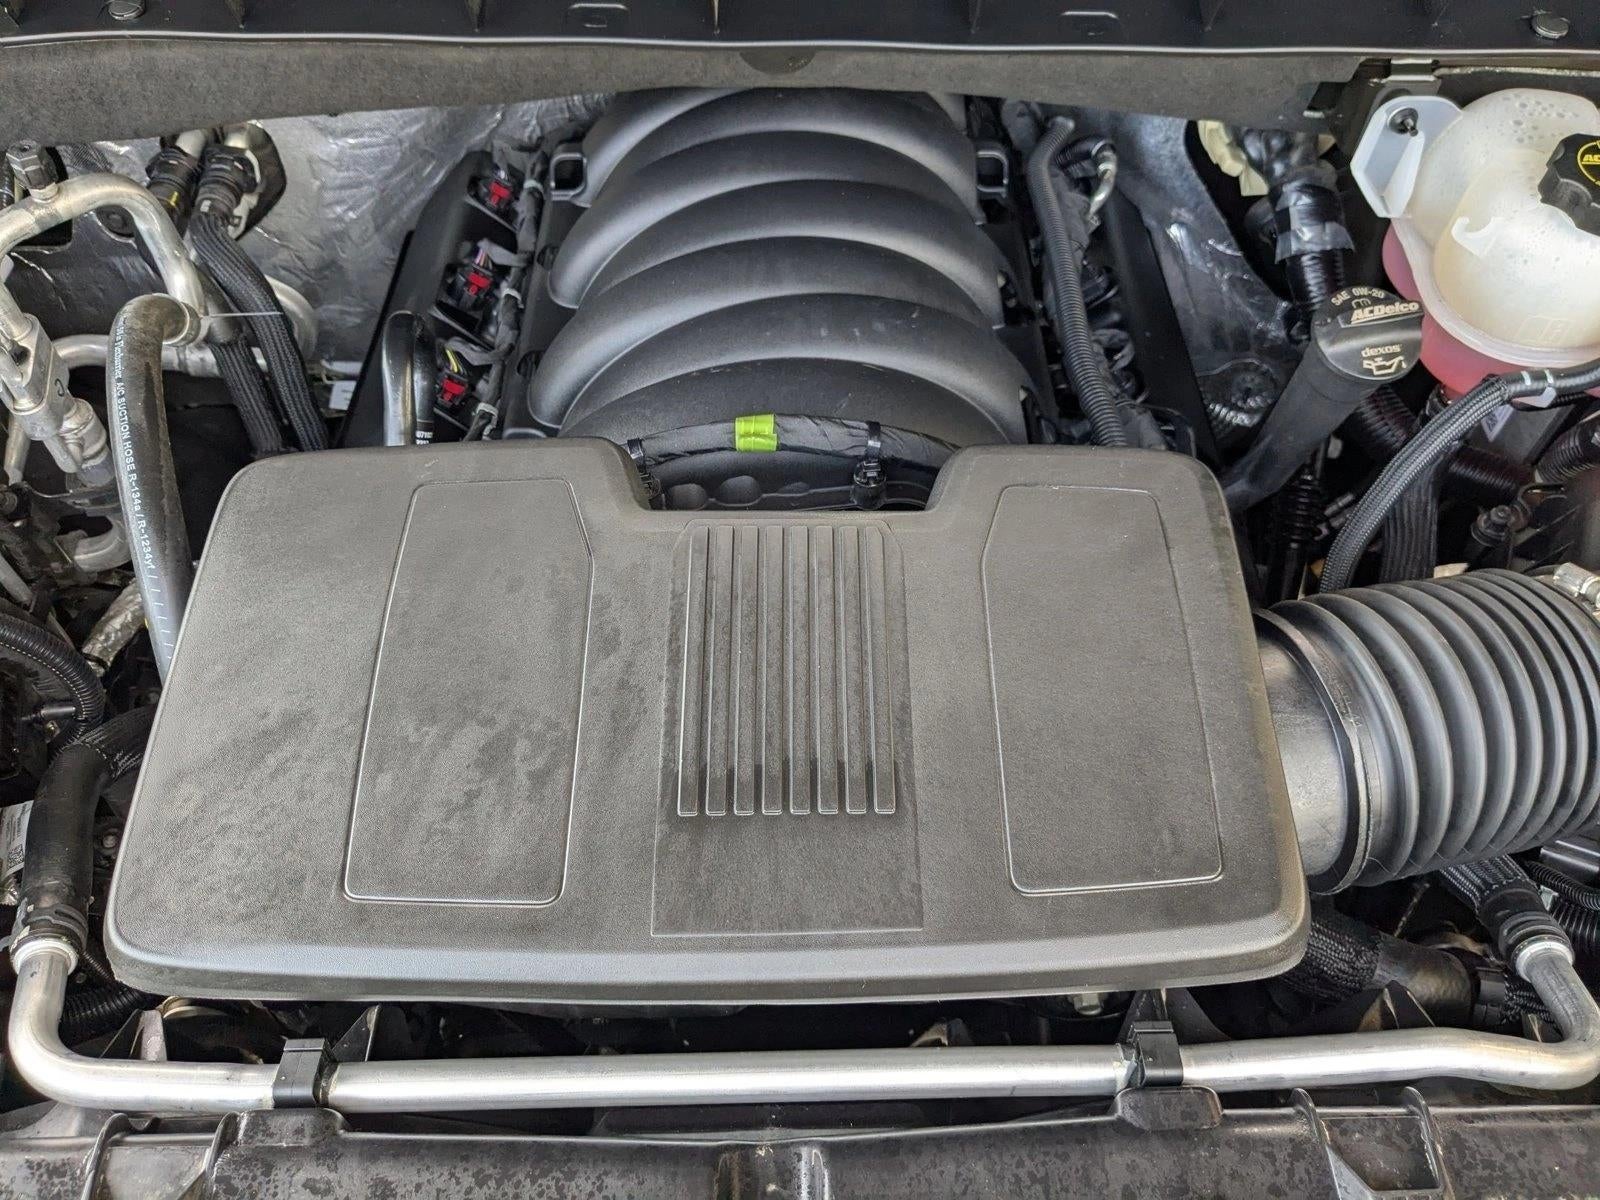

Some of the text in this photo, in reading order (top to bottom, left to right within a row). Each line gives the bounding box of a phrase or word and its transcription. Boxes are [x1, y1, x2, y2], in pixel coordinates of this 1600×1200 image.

[1331, 287, 1385, 306] SAE 0W-20
[1351, 301, 1420, 322] ACDelco
[1361, 344, 1402, 358] dexos
[117, 397, 131, 440] SUCTION
[123, 441, 136, 472] HOSE
[129, 473, 141, 512] R-134a
[138, 520, 155, 570] R-1234yf
